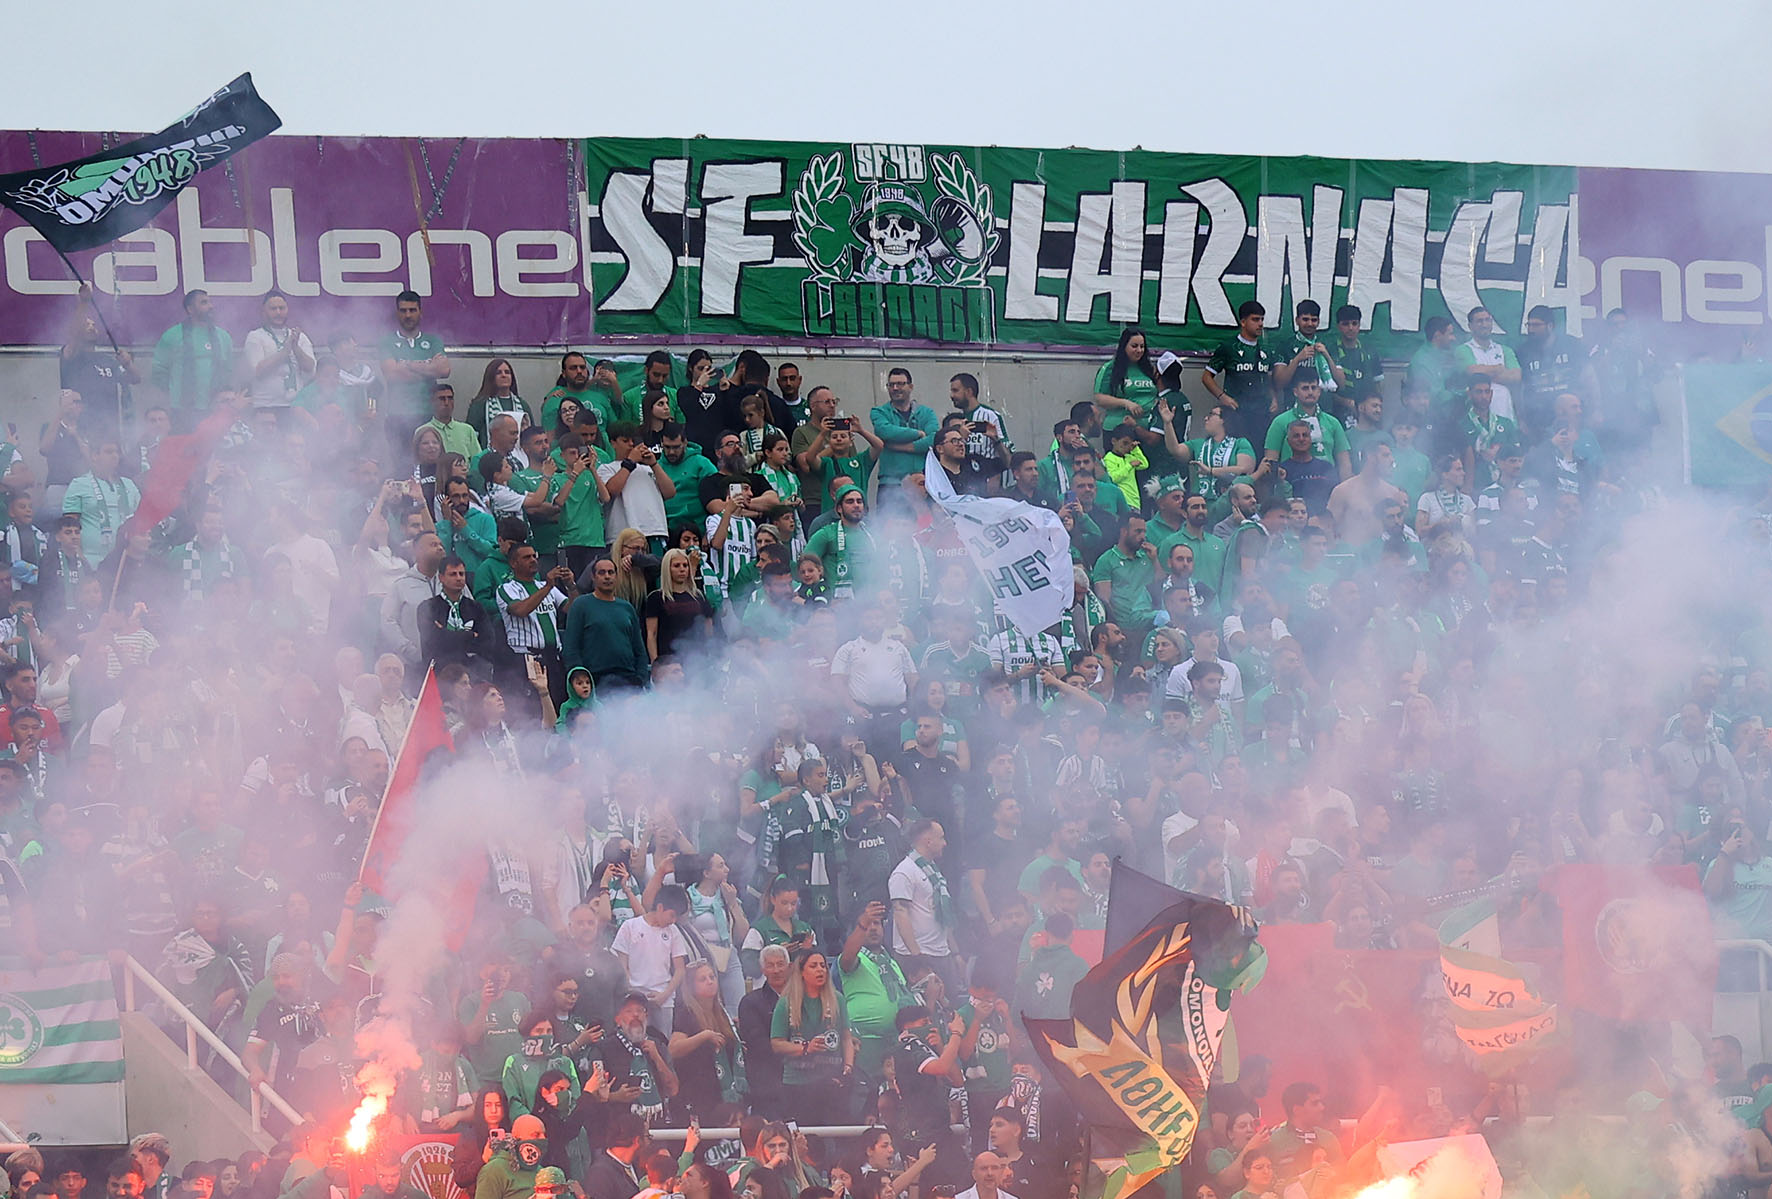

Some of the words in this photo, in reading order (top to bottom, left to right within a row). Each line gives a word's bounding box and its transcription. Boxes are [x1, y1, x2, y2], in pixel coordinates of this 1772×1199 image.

[122, 157, 200, 206] 1948
[3, 187, 592, 299] cablene
[1008, 178, 1580, 335] LARNACA
